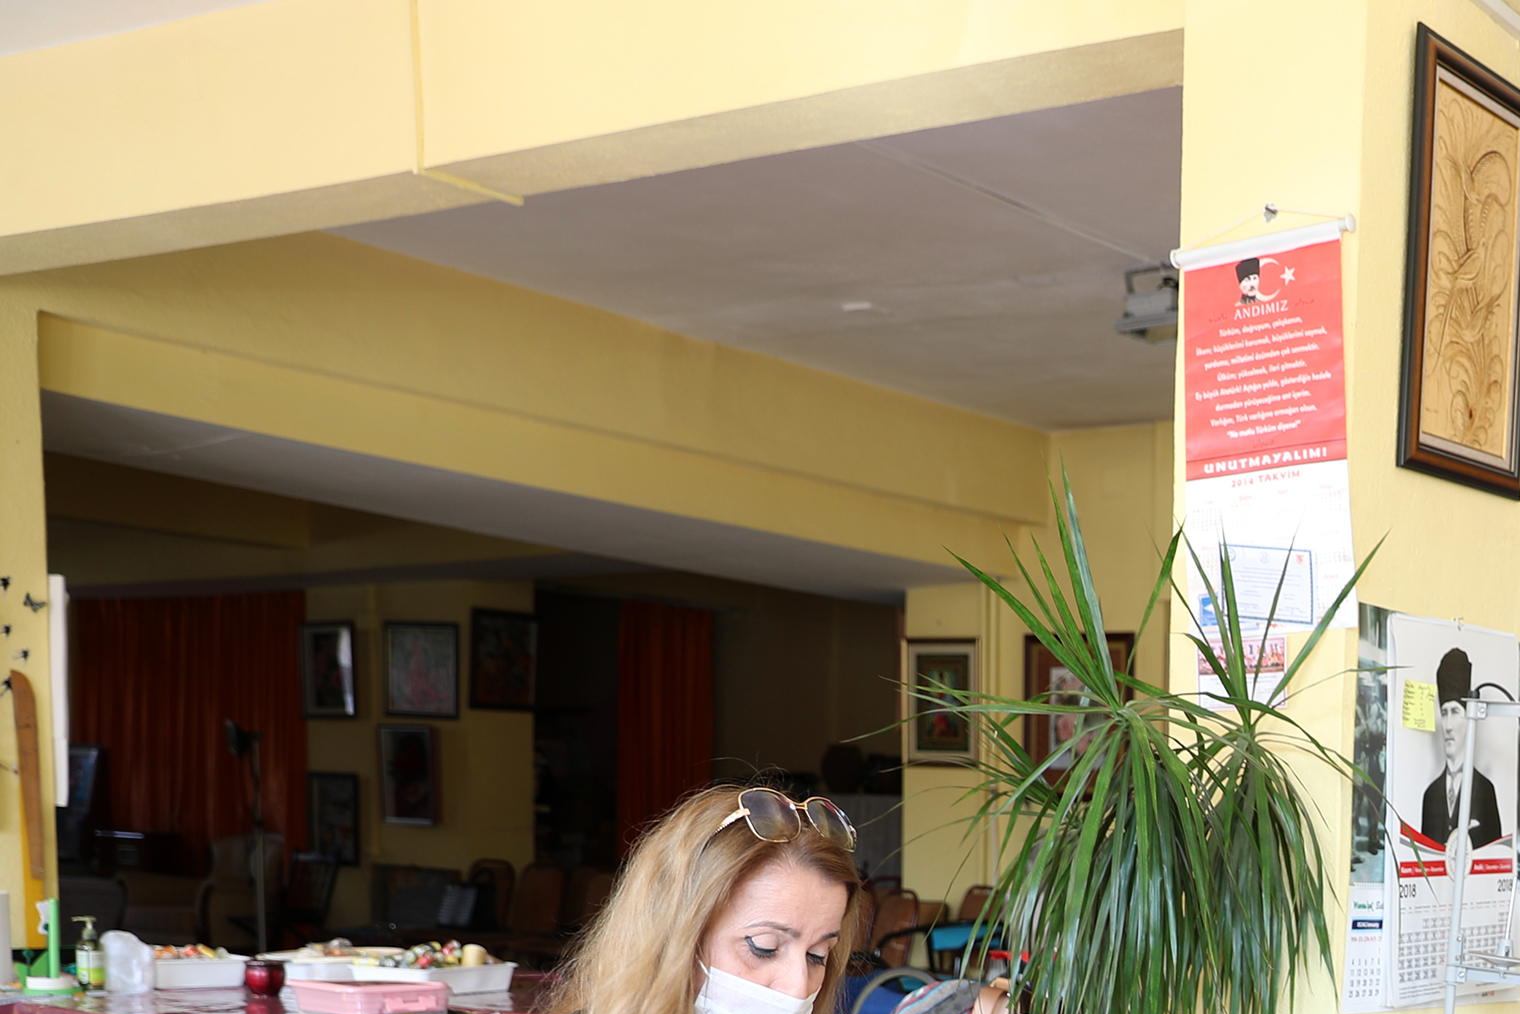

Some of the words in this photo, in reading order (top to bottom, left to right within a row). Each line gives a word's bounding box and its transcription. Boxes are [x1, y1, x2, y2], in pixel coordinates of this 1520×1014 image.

[1234, 300, 1289, 321] ANDIMIZ
[1236, 413, 1248, 422] Türk
[1255, 425, 1277, 435] Türküm
[1204, 447, 1327, 474] UNUTMAYALIM!
[1231, 479, 1254, 488] 2014
[1258, 469, 1300, 483] TAKVİM
[1399, 884, 1417, 898] 2018
[1497, 879, 1513, 892] 2018
